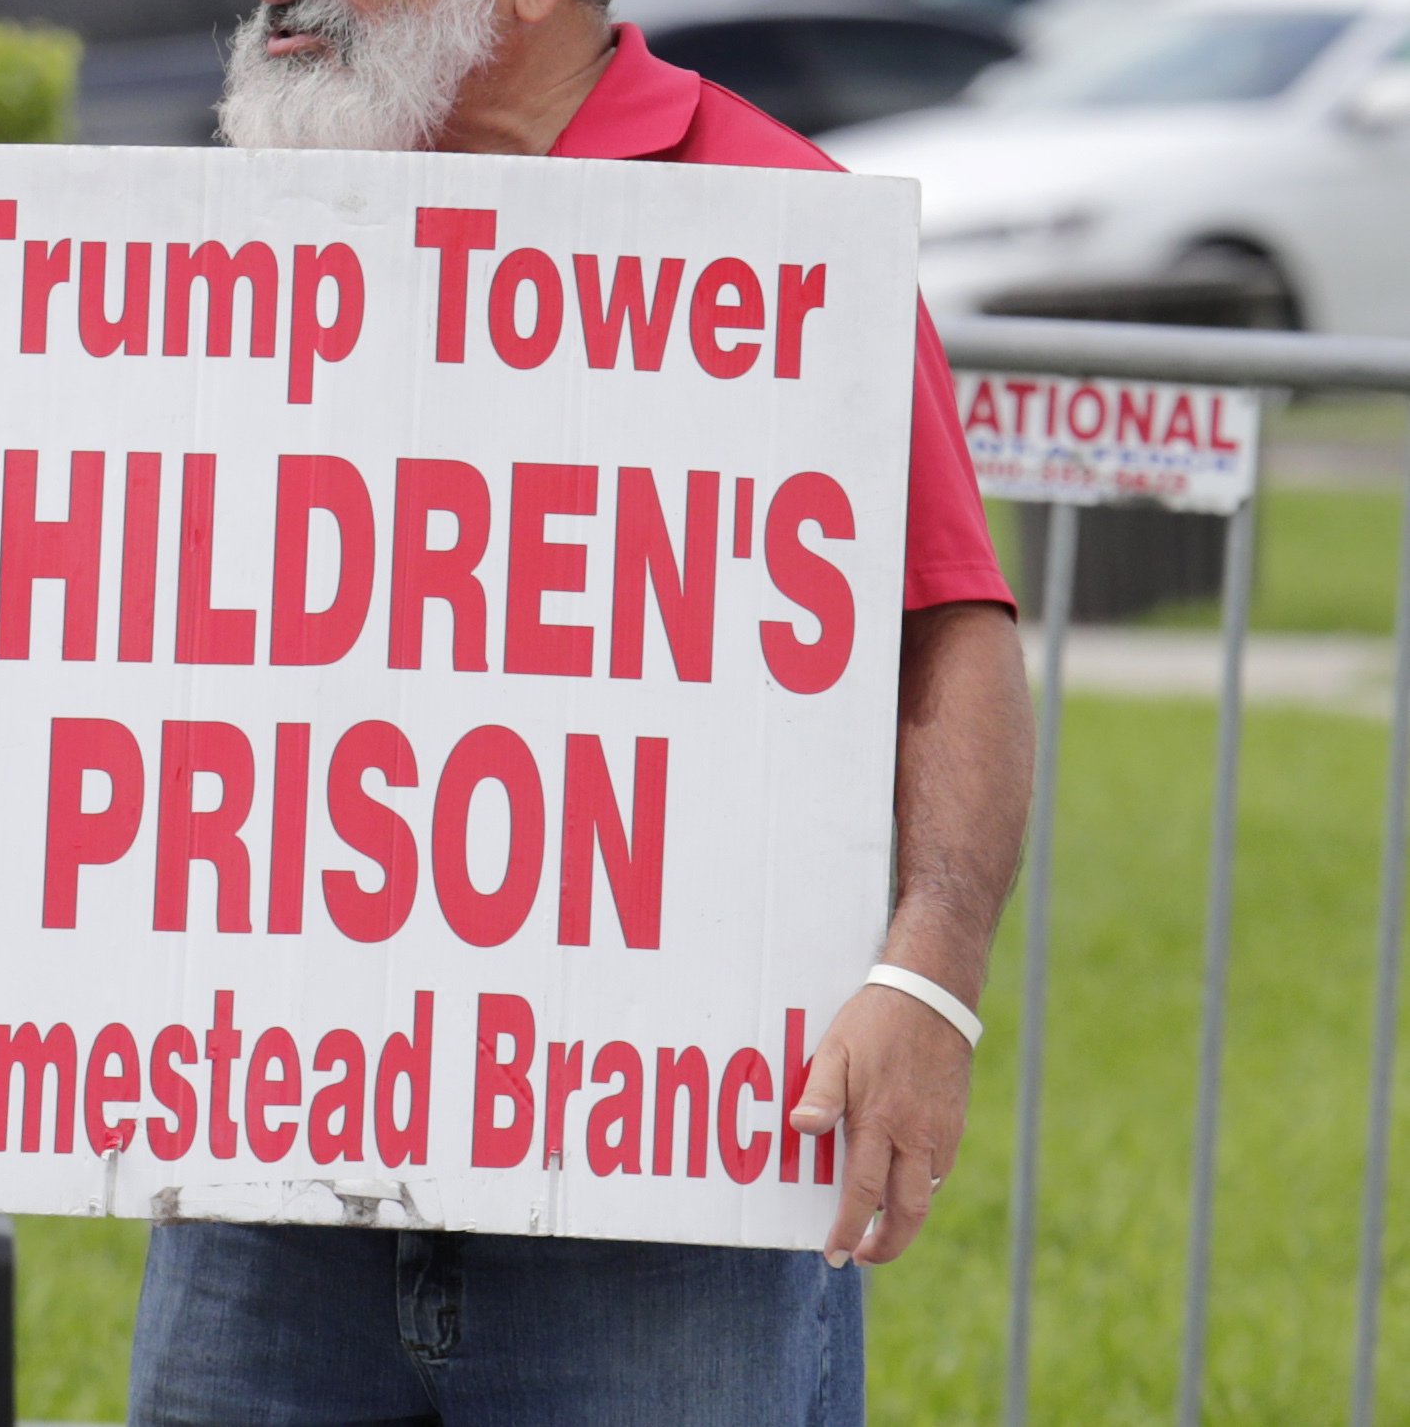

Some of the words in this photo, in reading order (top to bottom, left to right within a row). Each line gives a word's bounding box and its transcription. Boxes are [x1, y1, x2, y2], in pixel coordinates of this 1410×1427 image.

[414, 206, 827, 380] Tower
[952, 379, 1237, 452] ATIONAL
[41, 716, 670, 951] PRISON
[471, 993, 836, 1186] Branch
